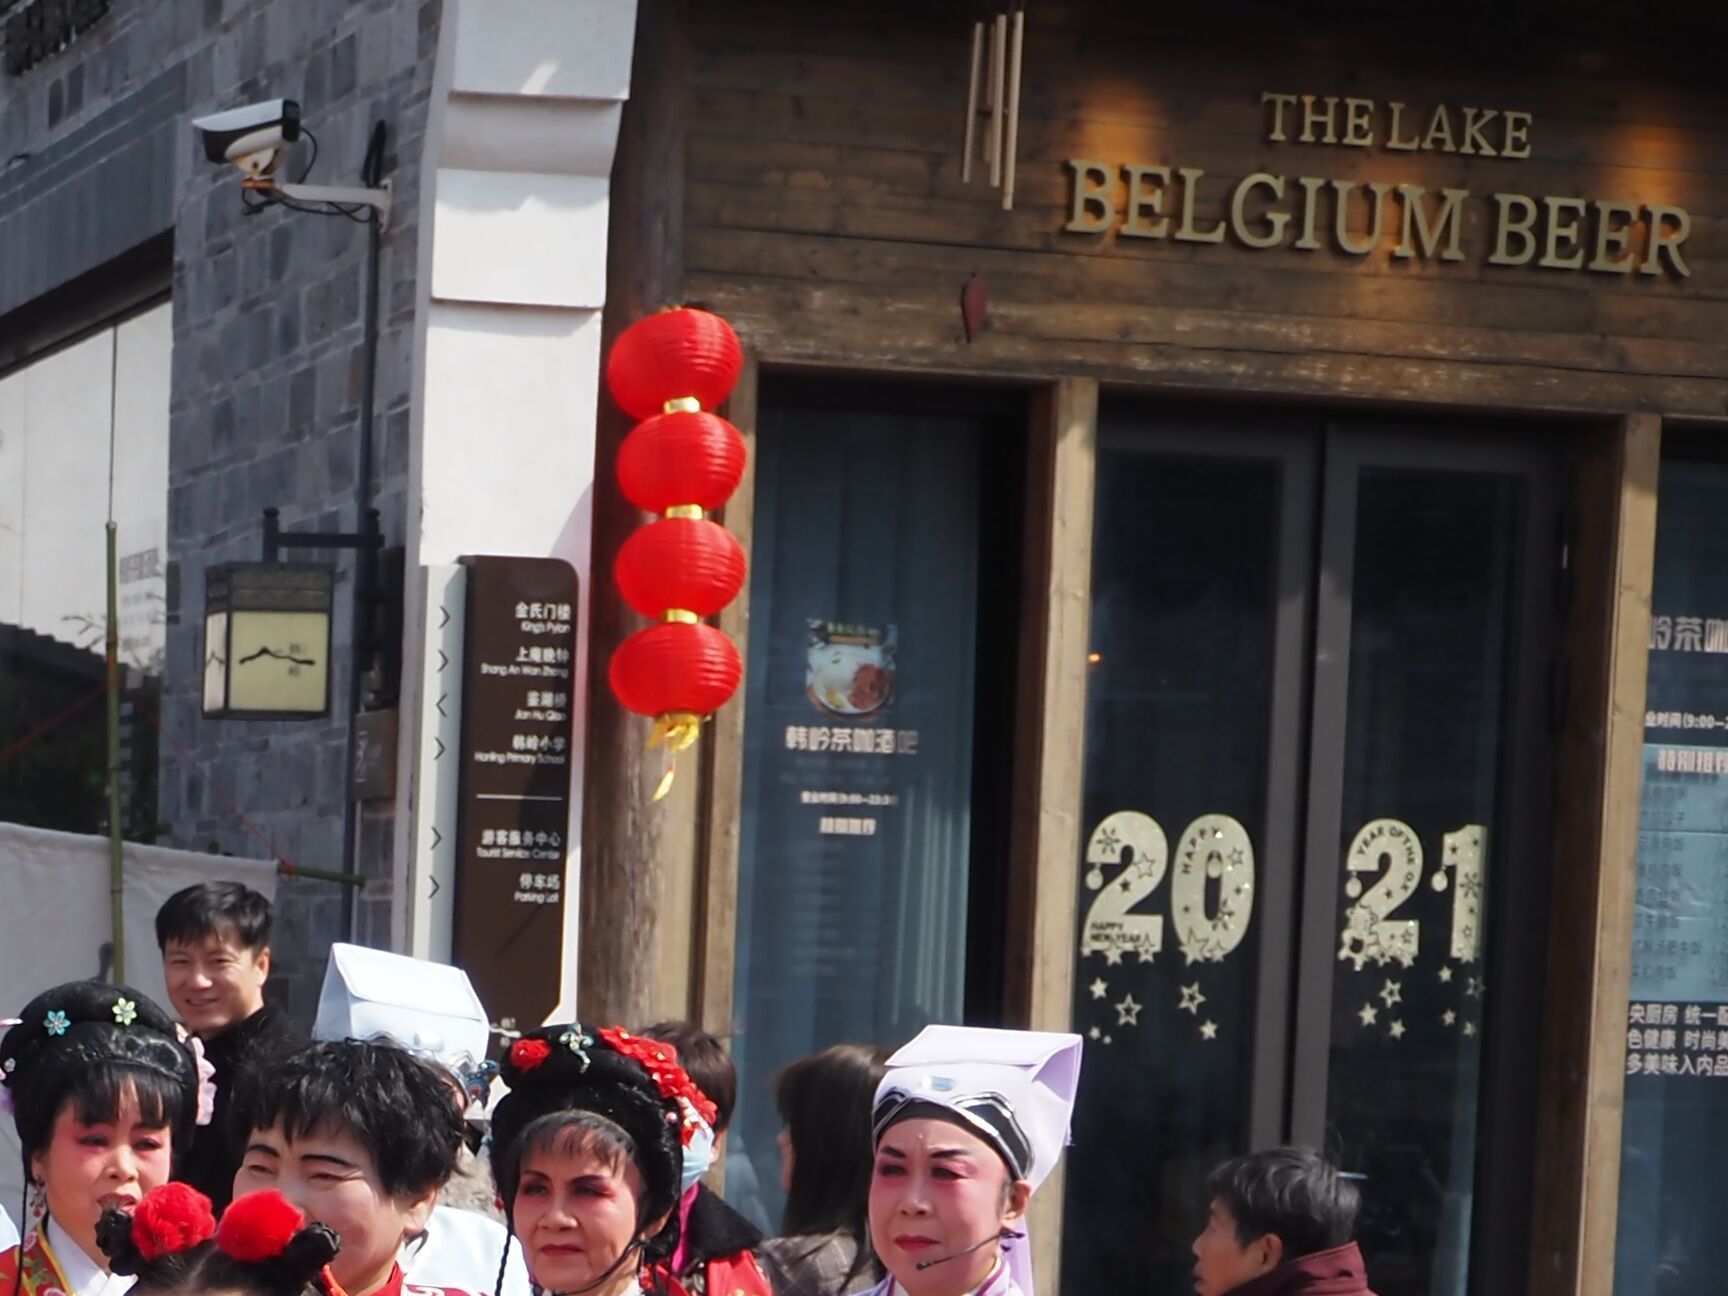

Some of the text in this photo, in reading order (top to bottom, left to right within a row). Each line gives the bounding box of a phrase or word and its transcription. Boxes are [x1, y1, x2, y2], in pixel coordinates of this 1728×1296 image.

[1261, 91, 1534, 158] THE LAKE
[1063, 159, 1693, 279] BELGIUM BEER
[1181, 825, 1222, 875] HAPPY
[1357, 826, 1385, 855] YEAR
[1402, 836, 1416, 865] THE
[521, 874, 560, 888] 停车场
[1082, 810, 1255, 960] 20
[1340, 818, 1488, 963] 21
[1401, 872, 1415, 892] OX
[514, 892, 545, 903] Parking
